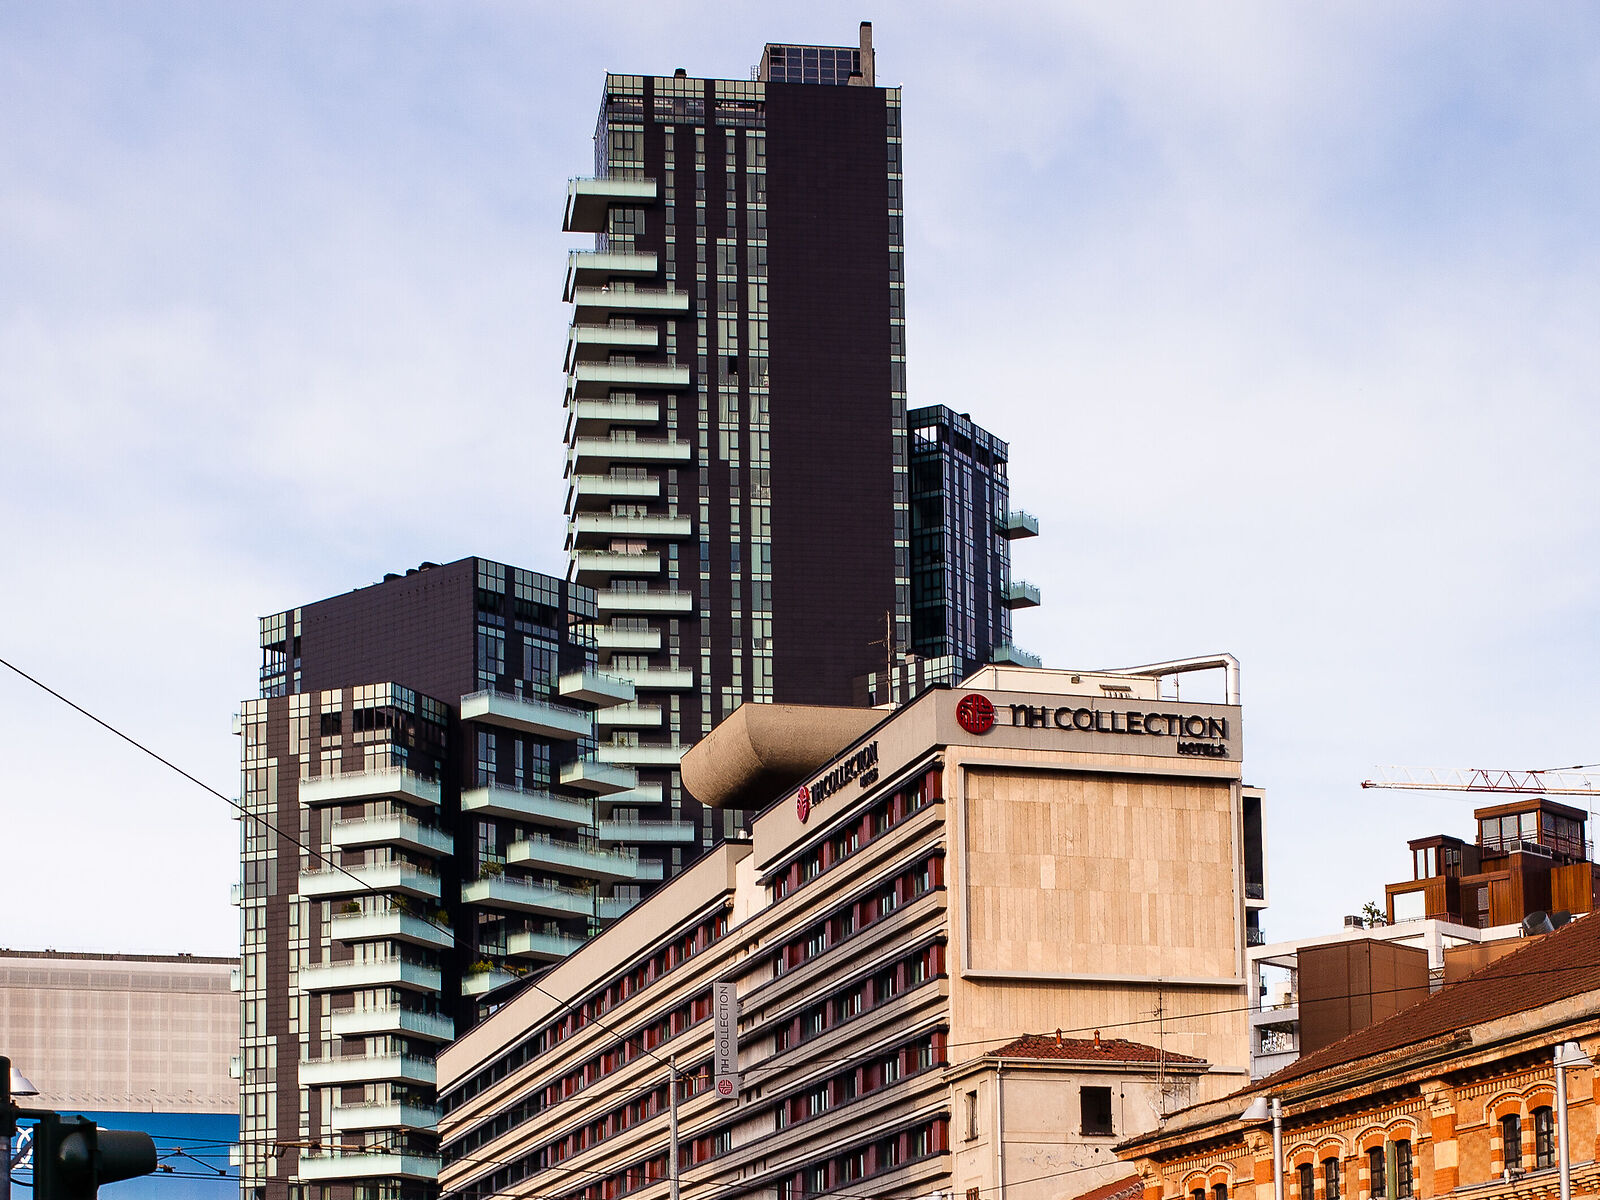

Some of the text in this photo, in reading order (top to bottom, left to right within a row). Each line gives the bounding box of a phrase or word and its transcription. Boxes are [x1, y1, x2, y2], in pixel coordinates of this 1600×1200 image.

[1054, 707, 1226, 739] COLLECTION
[824, 741, 879, 797] COLLECTION
[720, 986, 729, 1057] COLLECTION
